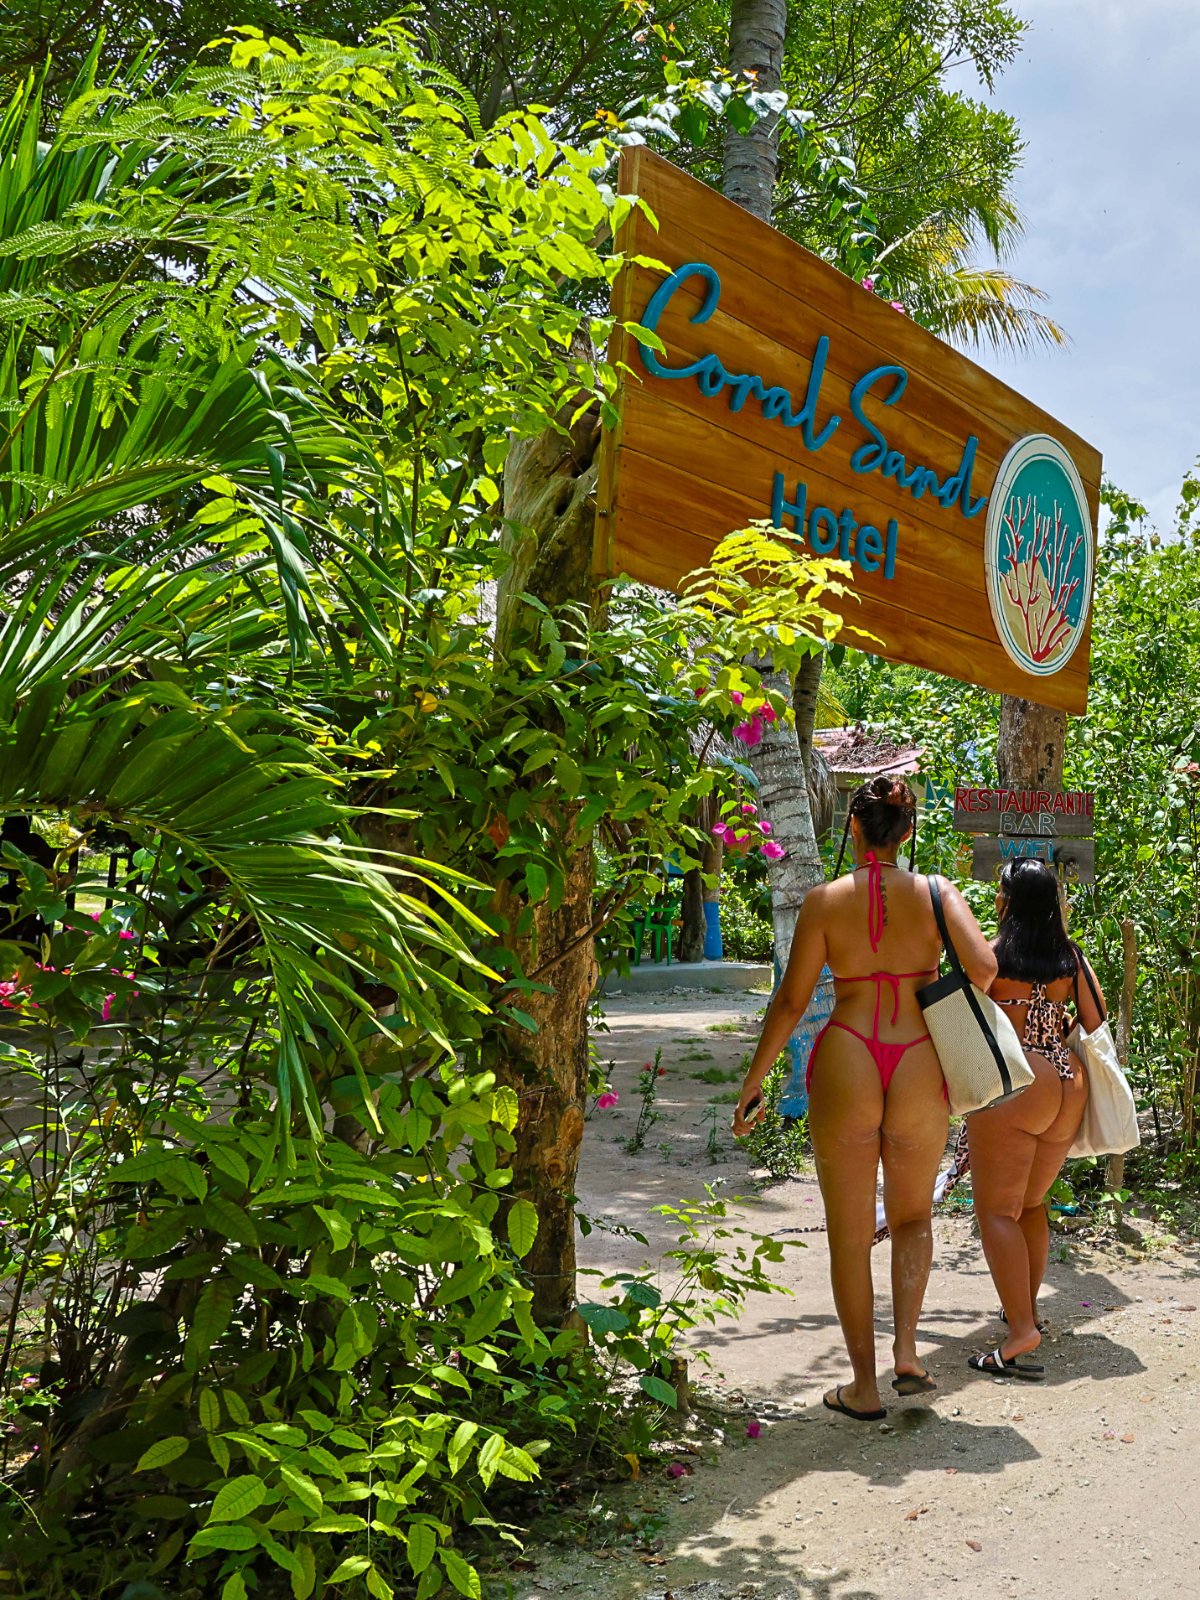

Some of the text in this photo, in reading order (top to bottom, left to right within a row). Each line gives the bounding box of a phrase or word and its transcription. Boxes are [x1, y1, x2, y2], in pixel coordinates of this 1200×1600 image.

[638, 262, 987, 518] Coral Sand
[771, 472, 899, 580] Hotel
[954, 787, 1095, 816] RESTAURANTE
[1000, 812, 1057, 835] BAR
